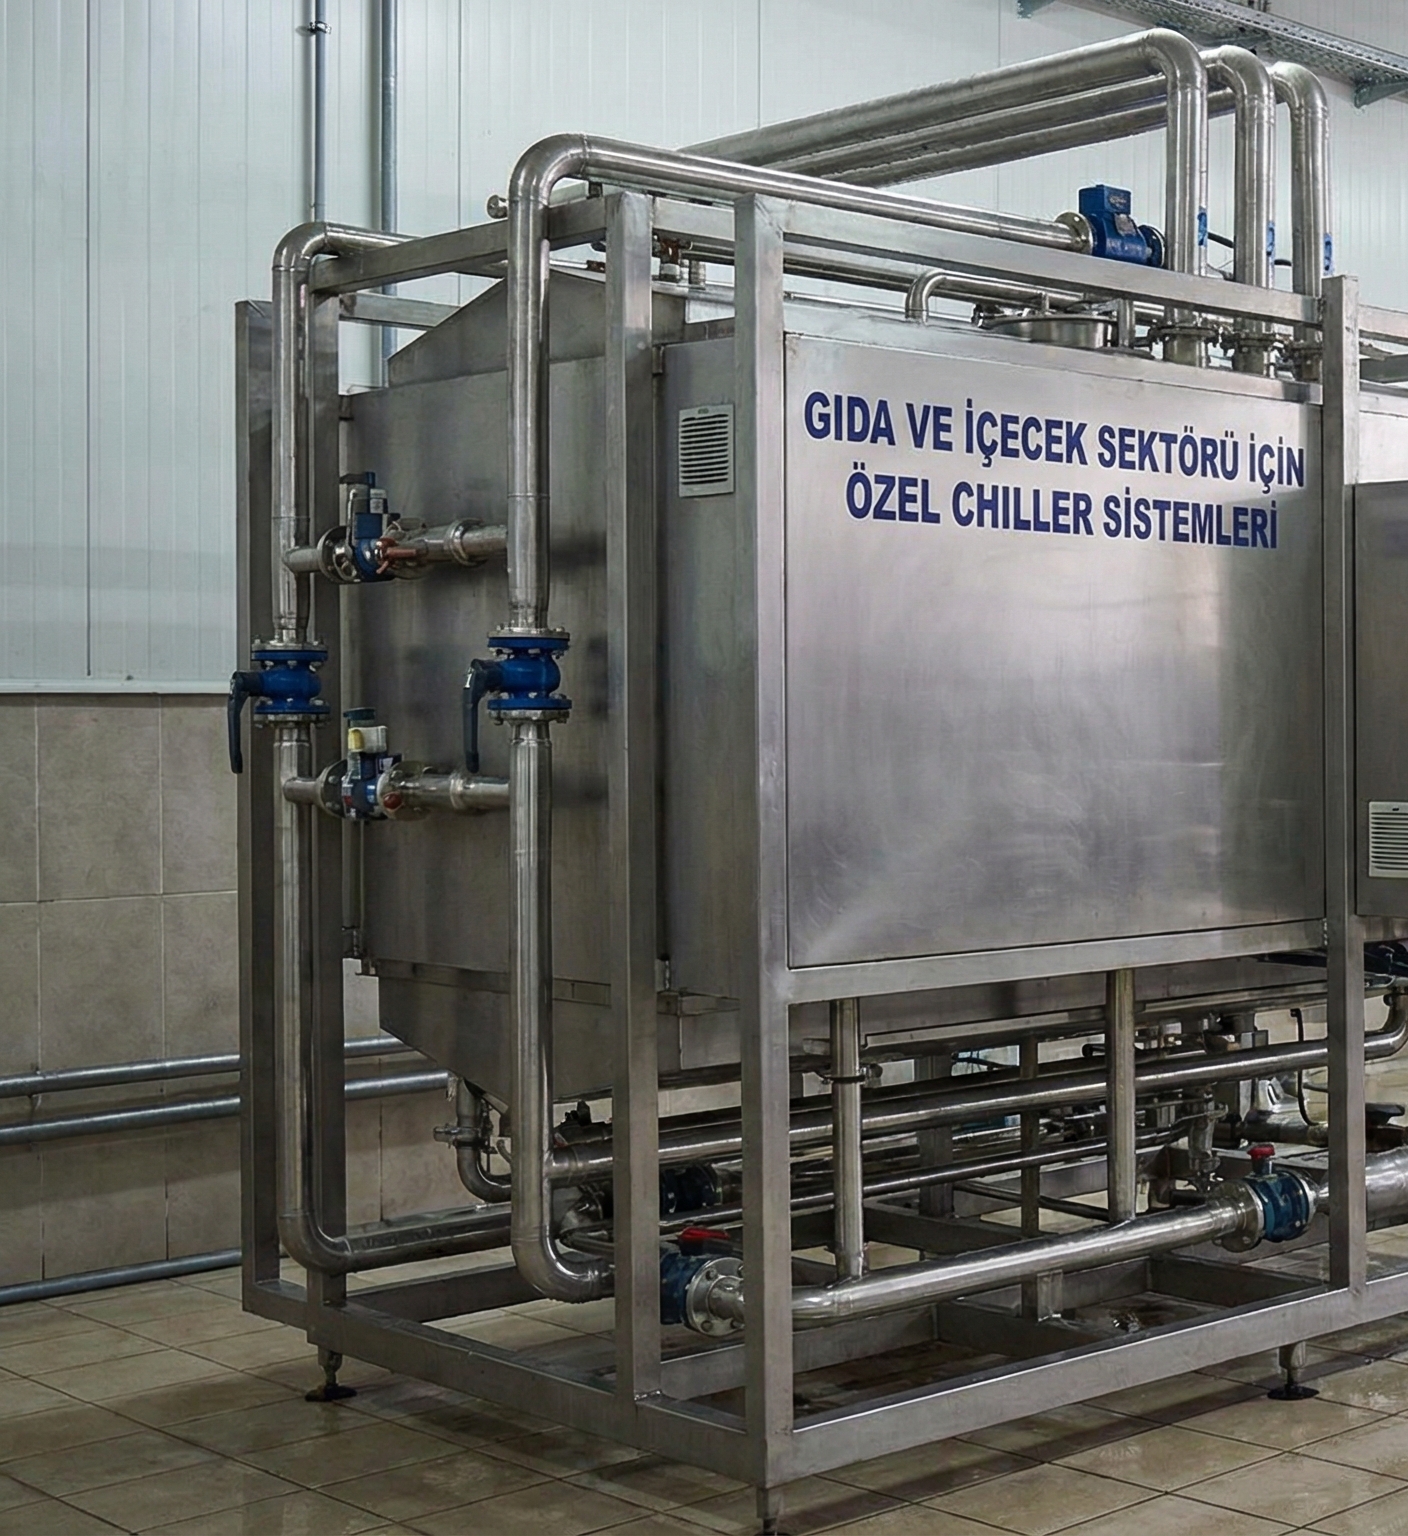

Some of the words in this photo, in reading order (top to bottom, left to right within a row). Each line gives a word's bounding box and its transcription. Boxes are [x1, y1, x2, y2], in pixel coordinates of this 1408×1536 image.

[805, 391, 895, 445] GIDA
[906, 403, 953, 452] VE
[965, 398, 1087, 467] İÇECEK
[1098, 425, 1238, 481] SEKTÖRÜ
[1249, 432, 1304, 494] İÇİN
[846, 462, 940, 525] ÖZEL
[952, 482, 1093, 536] CHILLER
[1103, 486, 1277, 549] SİSTEMLERİ
